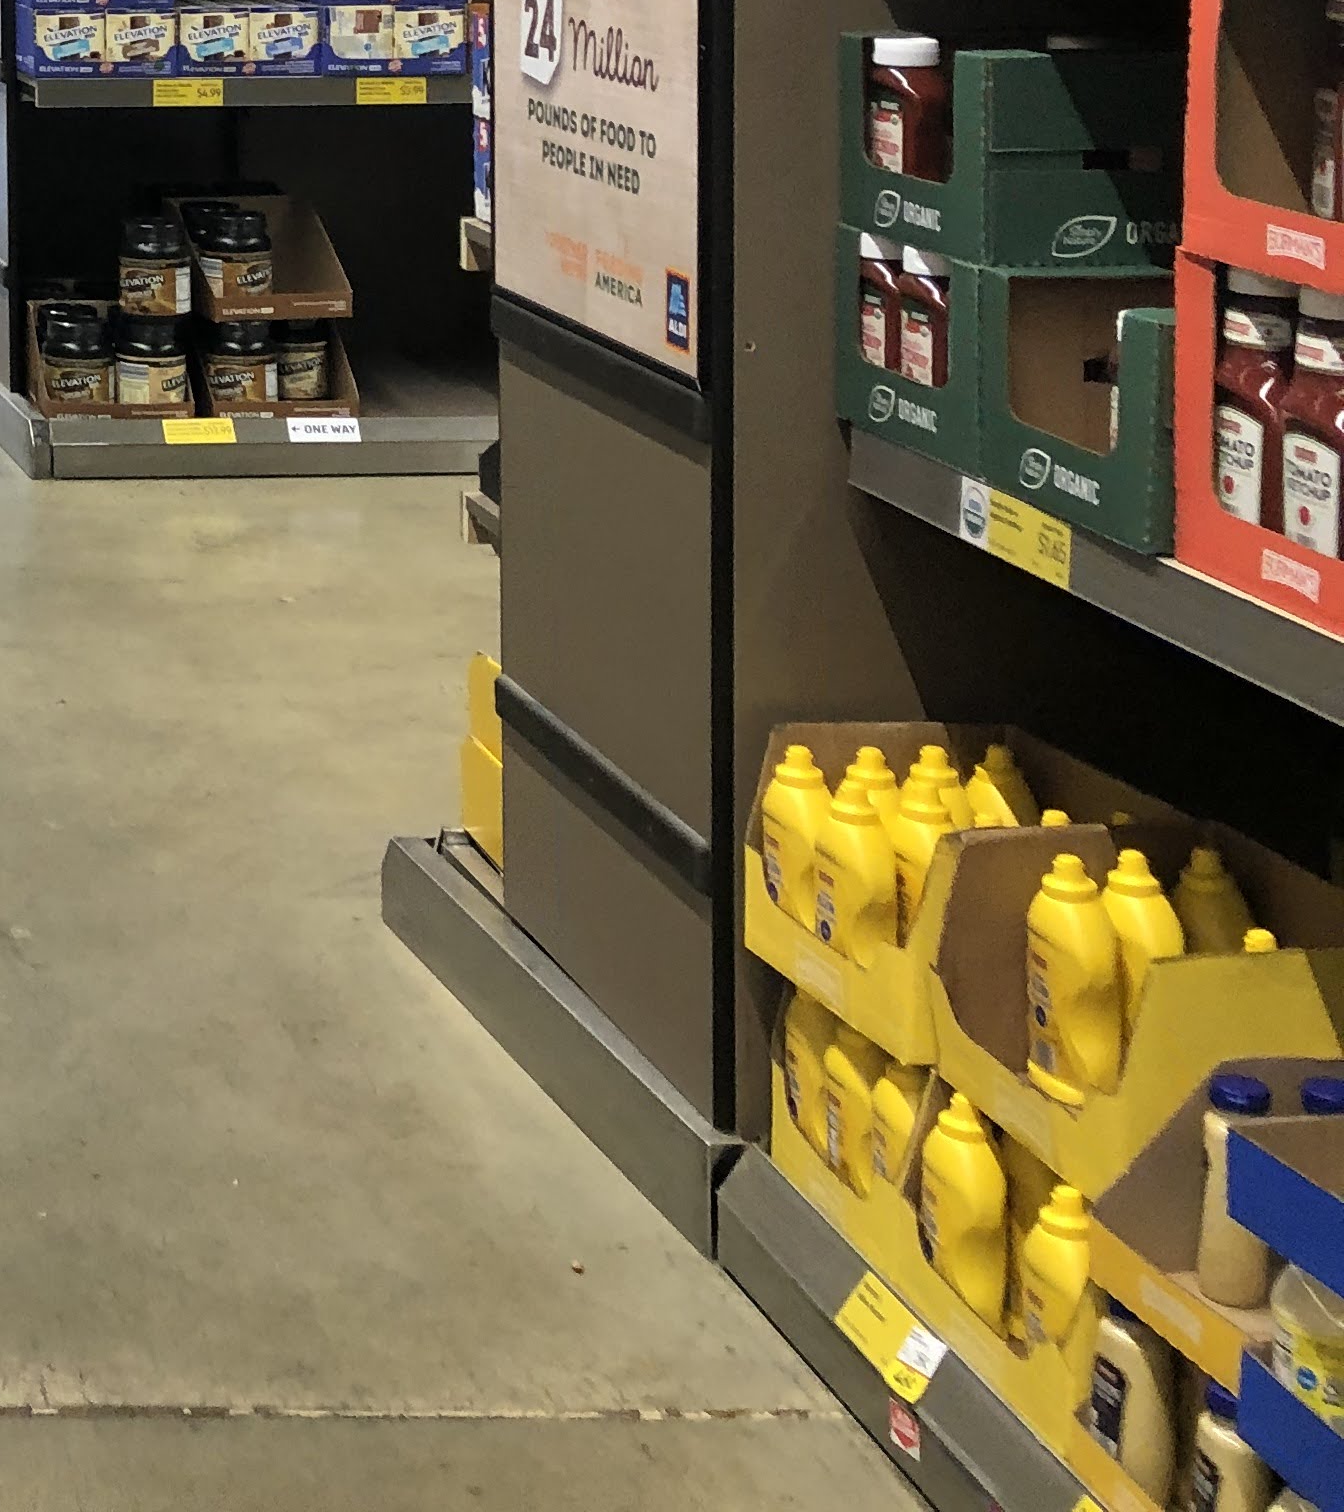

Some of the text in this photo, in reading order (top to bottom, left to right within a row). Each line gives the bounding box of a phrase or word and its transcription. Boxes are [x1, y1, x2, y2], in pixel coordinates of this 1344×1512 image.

[568, 16, 660, 92] Million
[527, 97, 657, 159] POUNDS OF FOOD TO
[541, 139, 641, 196] PEOPLE IN NEED
[903, 201, 942, 232] ORGANIC
[594, 271, 643, 308] AMERICA
[304, 424, 357, 435] ONE WAY
[898, 398, 938, 434] ORGANIC
[1052, 464, 1101, 506] ORGANIC
